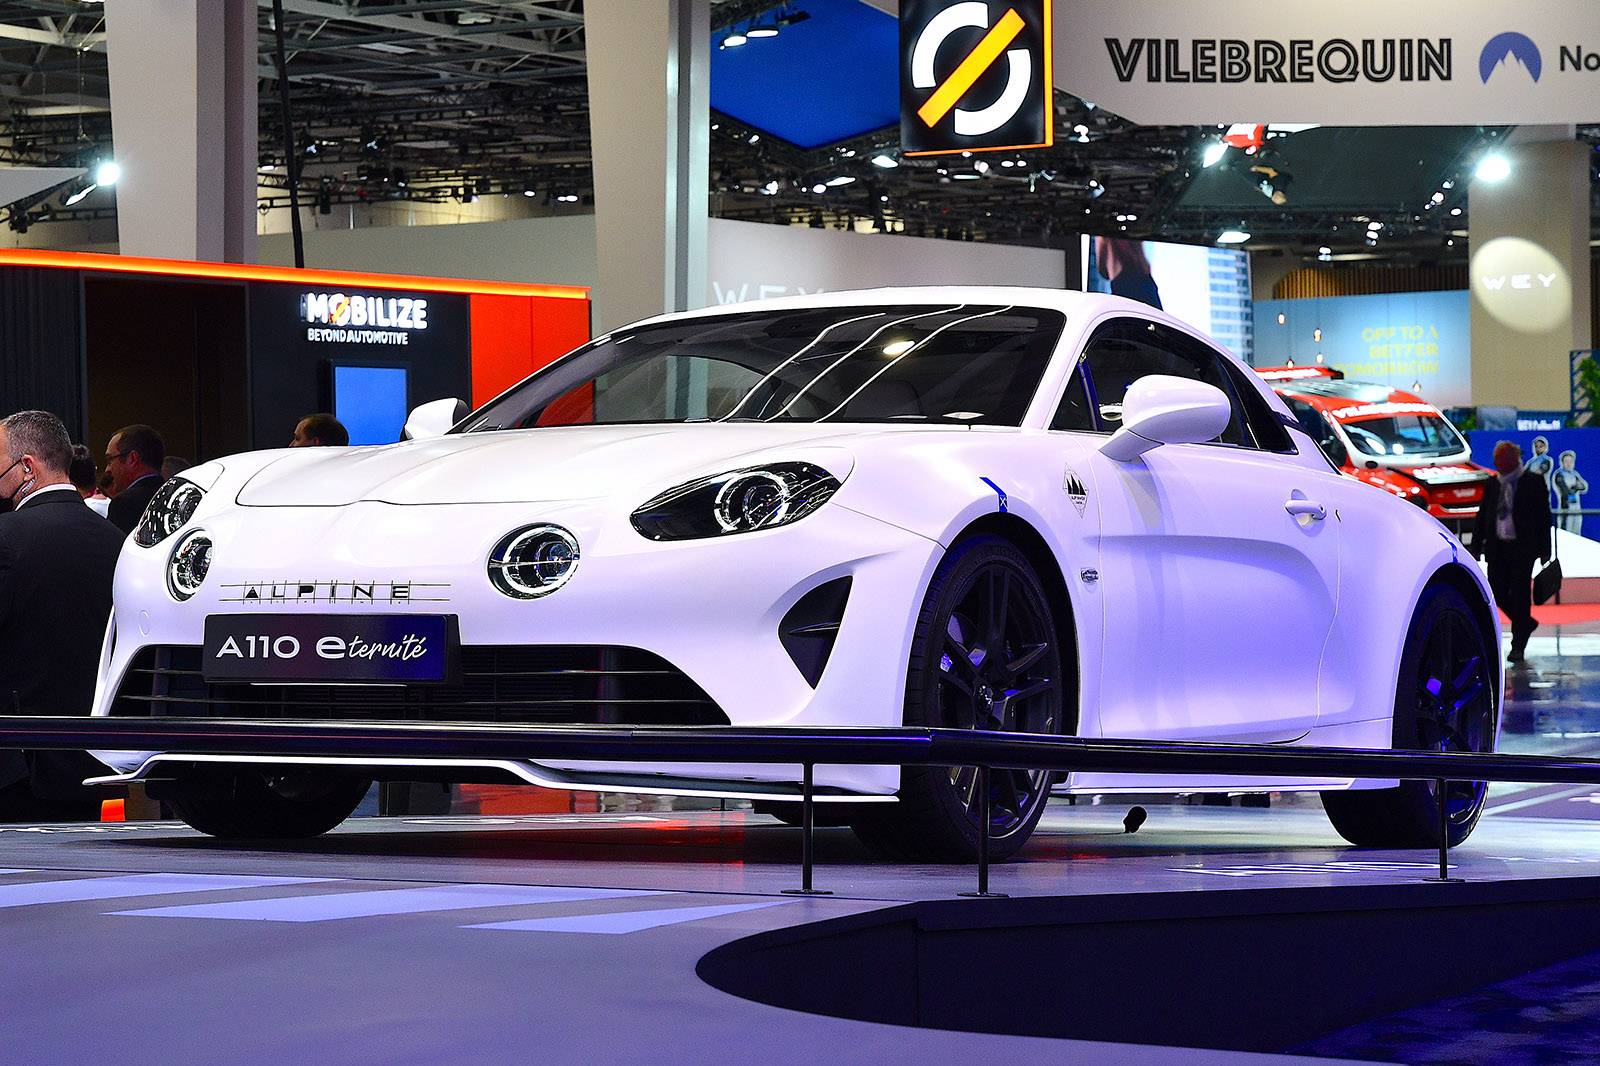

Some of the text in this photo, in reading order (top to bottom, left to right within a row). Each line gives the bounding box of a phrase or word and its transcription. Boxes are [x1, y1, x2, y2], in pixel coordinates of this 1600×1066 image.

[1105, 38, 1452, 83] VILEBREQUIN
[1482, 273, 1556, 290] WEY
[306, 293, 428, 329] MOBILIZE
[308, 328, 408, 345] BEYOND AUTOMOTIVE
[1362, 327, 1396, 342] OFF
[1399, 325, 1423, 340] TO
[1370, 342, 1439, 359] BETTER
[244, 585, 410, 599] ALPINE
[215, 634, 428, 661] A110 eternité
